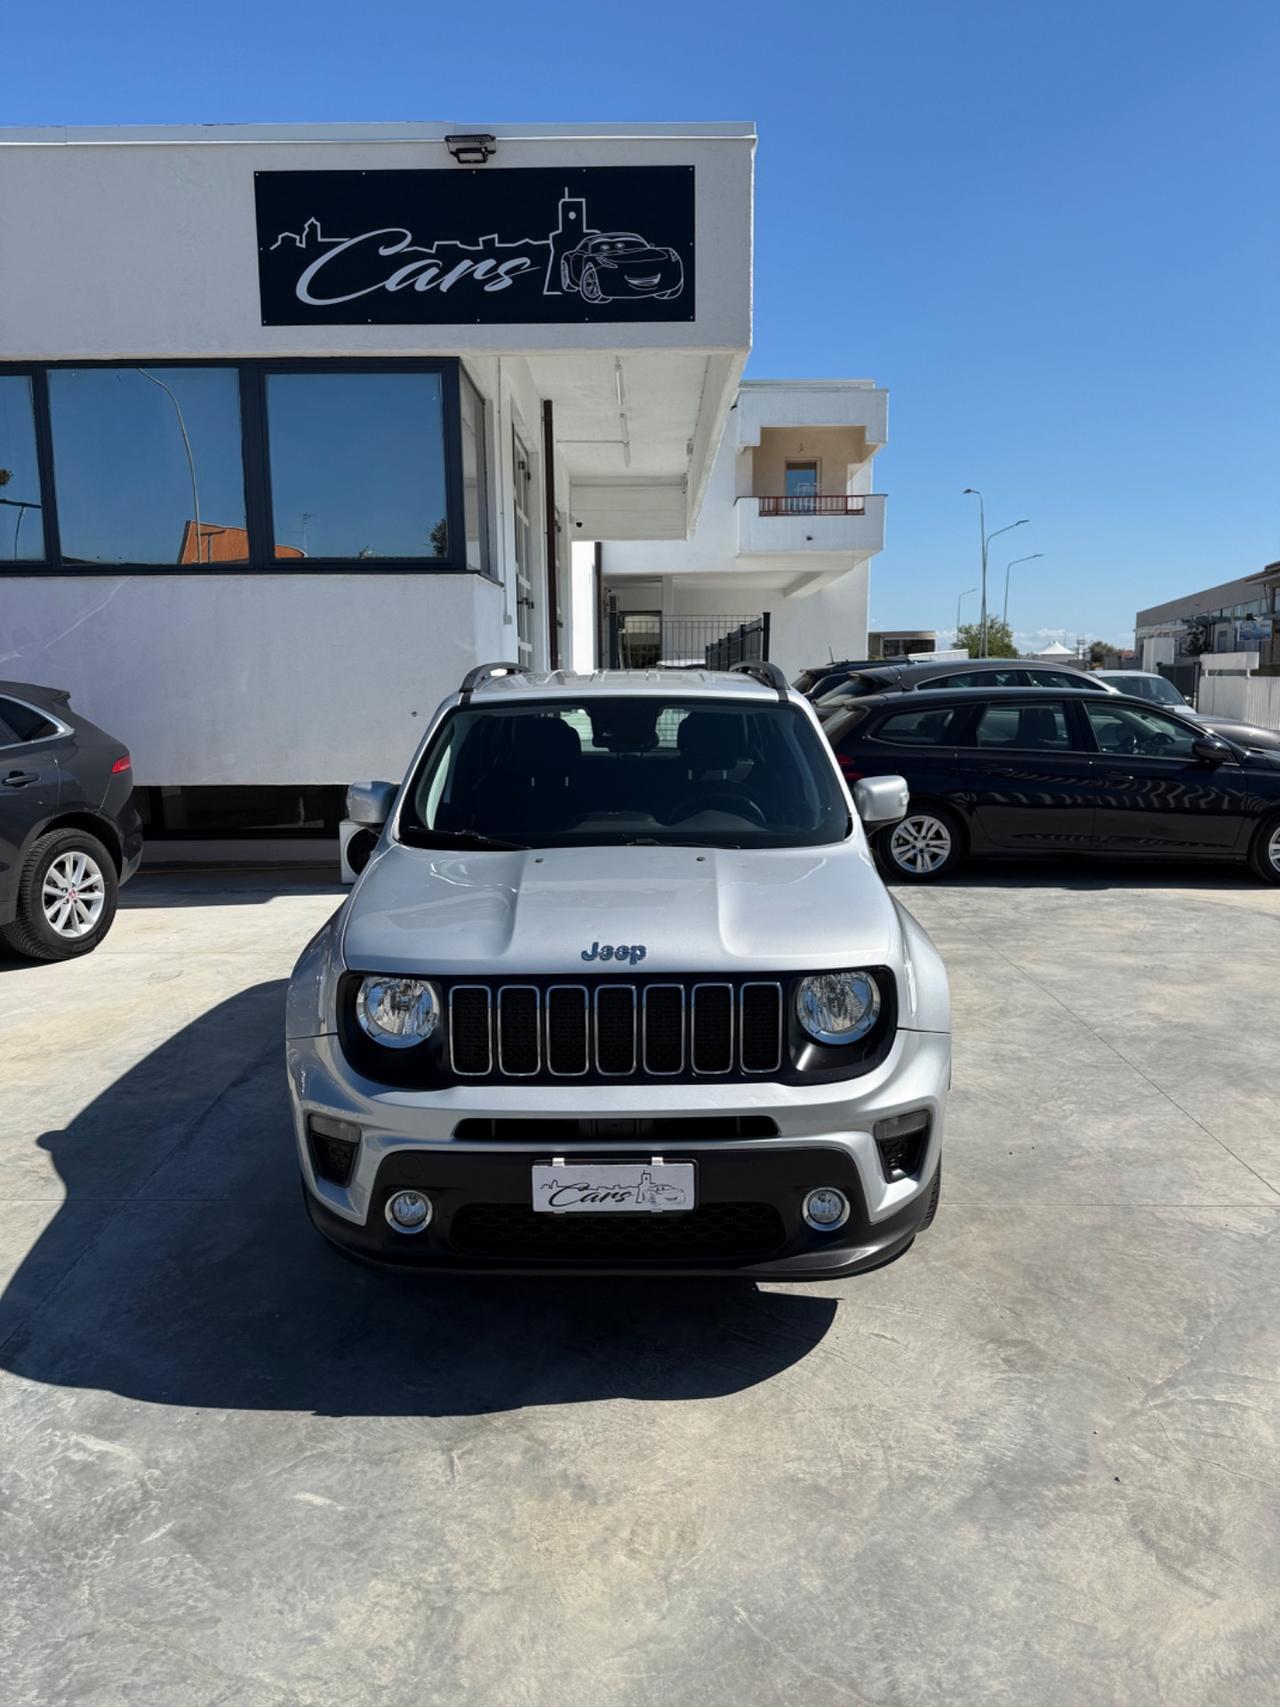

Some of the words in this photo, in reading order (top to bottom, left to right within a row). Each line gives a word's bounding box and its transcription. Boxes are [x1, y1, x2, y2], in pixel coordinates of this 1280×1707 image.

[296, 228, 540, 305] Cars
[581, 941, 647, 965] Jeep
[549, 1182, 632, 1207] Cars
